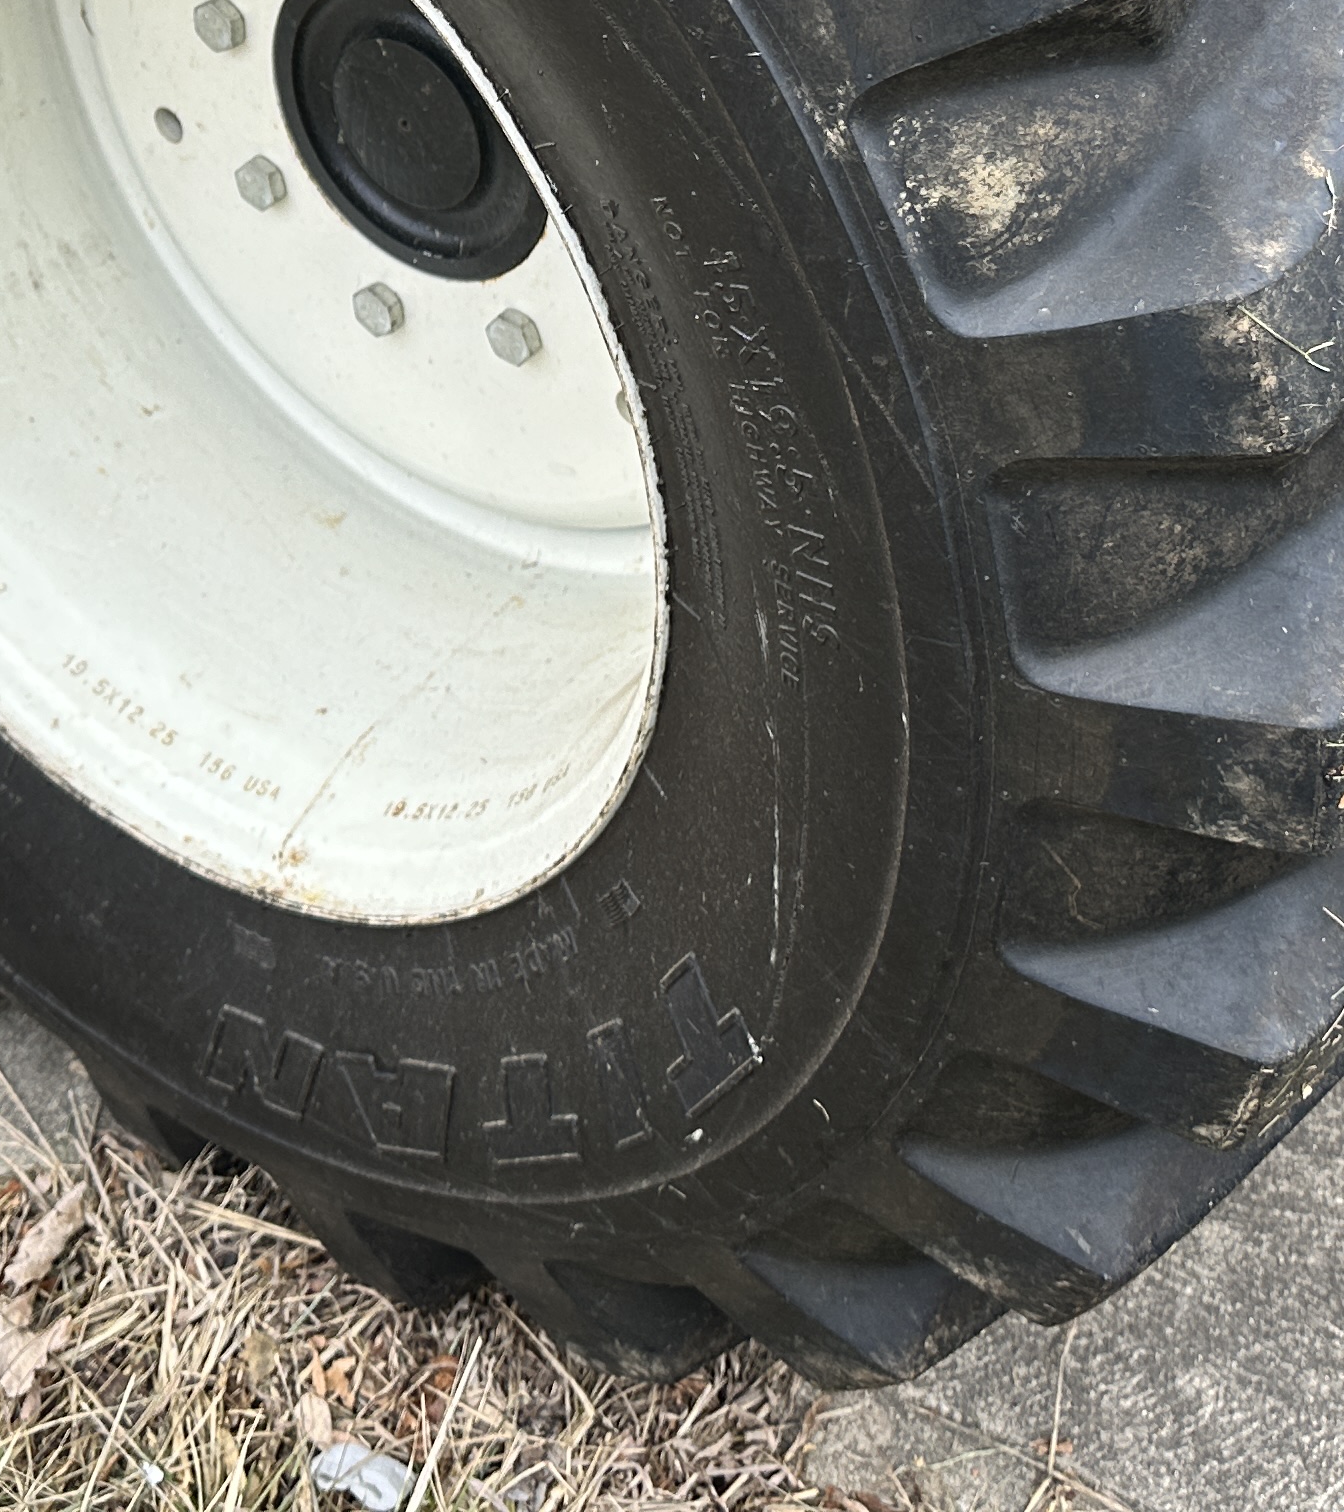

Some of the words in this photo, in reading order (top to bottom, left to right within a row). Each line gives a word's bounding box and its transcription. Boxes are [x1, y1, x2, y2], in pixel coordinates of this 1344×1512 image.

[729, 381, 785, 538] HIGHWAY
[763, 559, 802, 690] SERVICE
[199, 951, 763, 1165] TITAN
